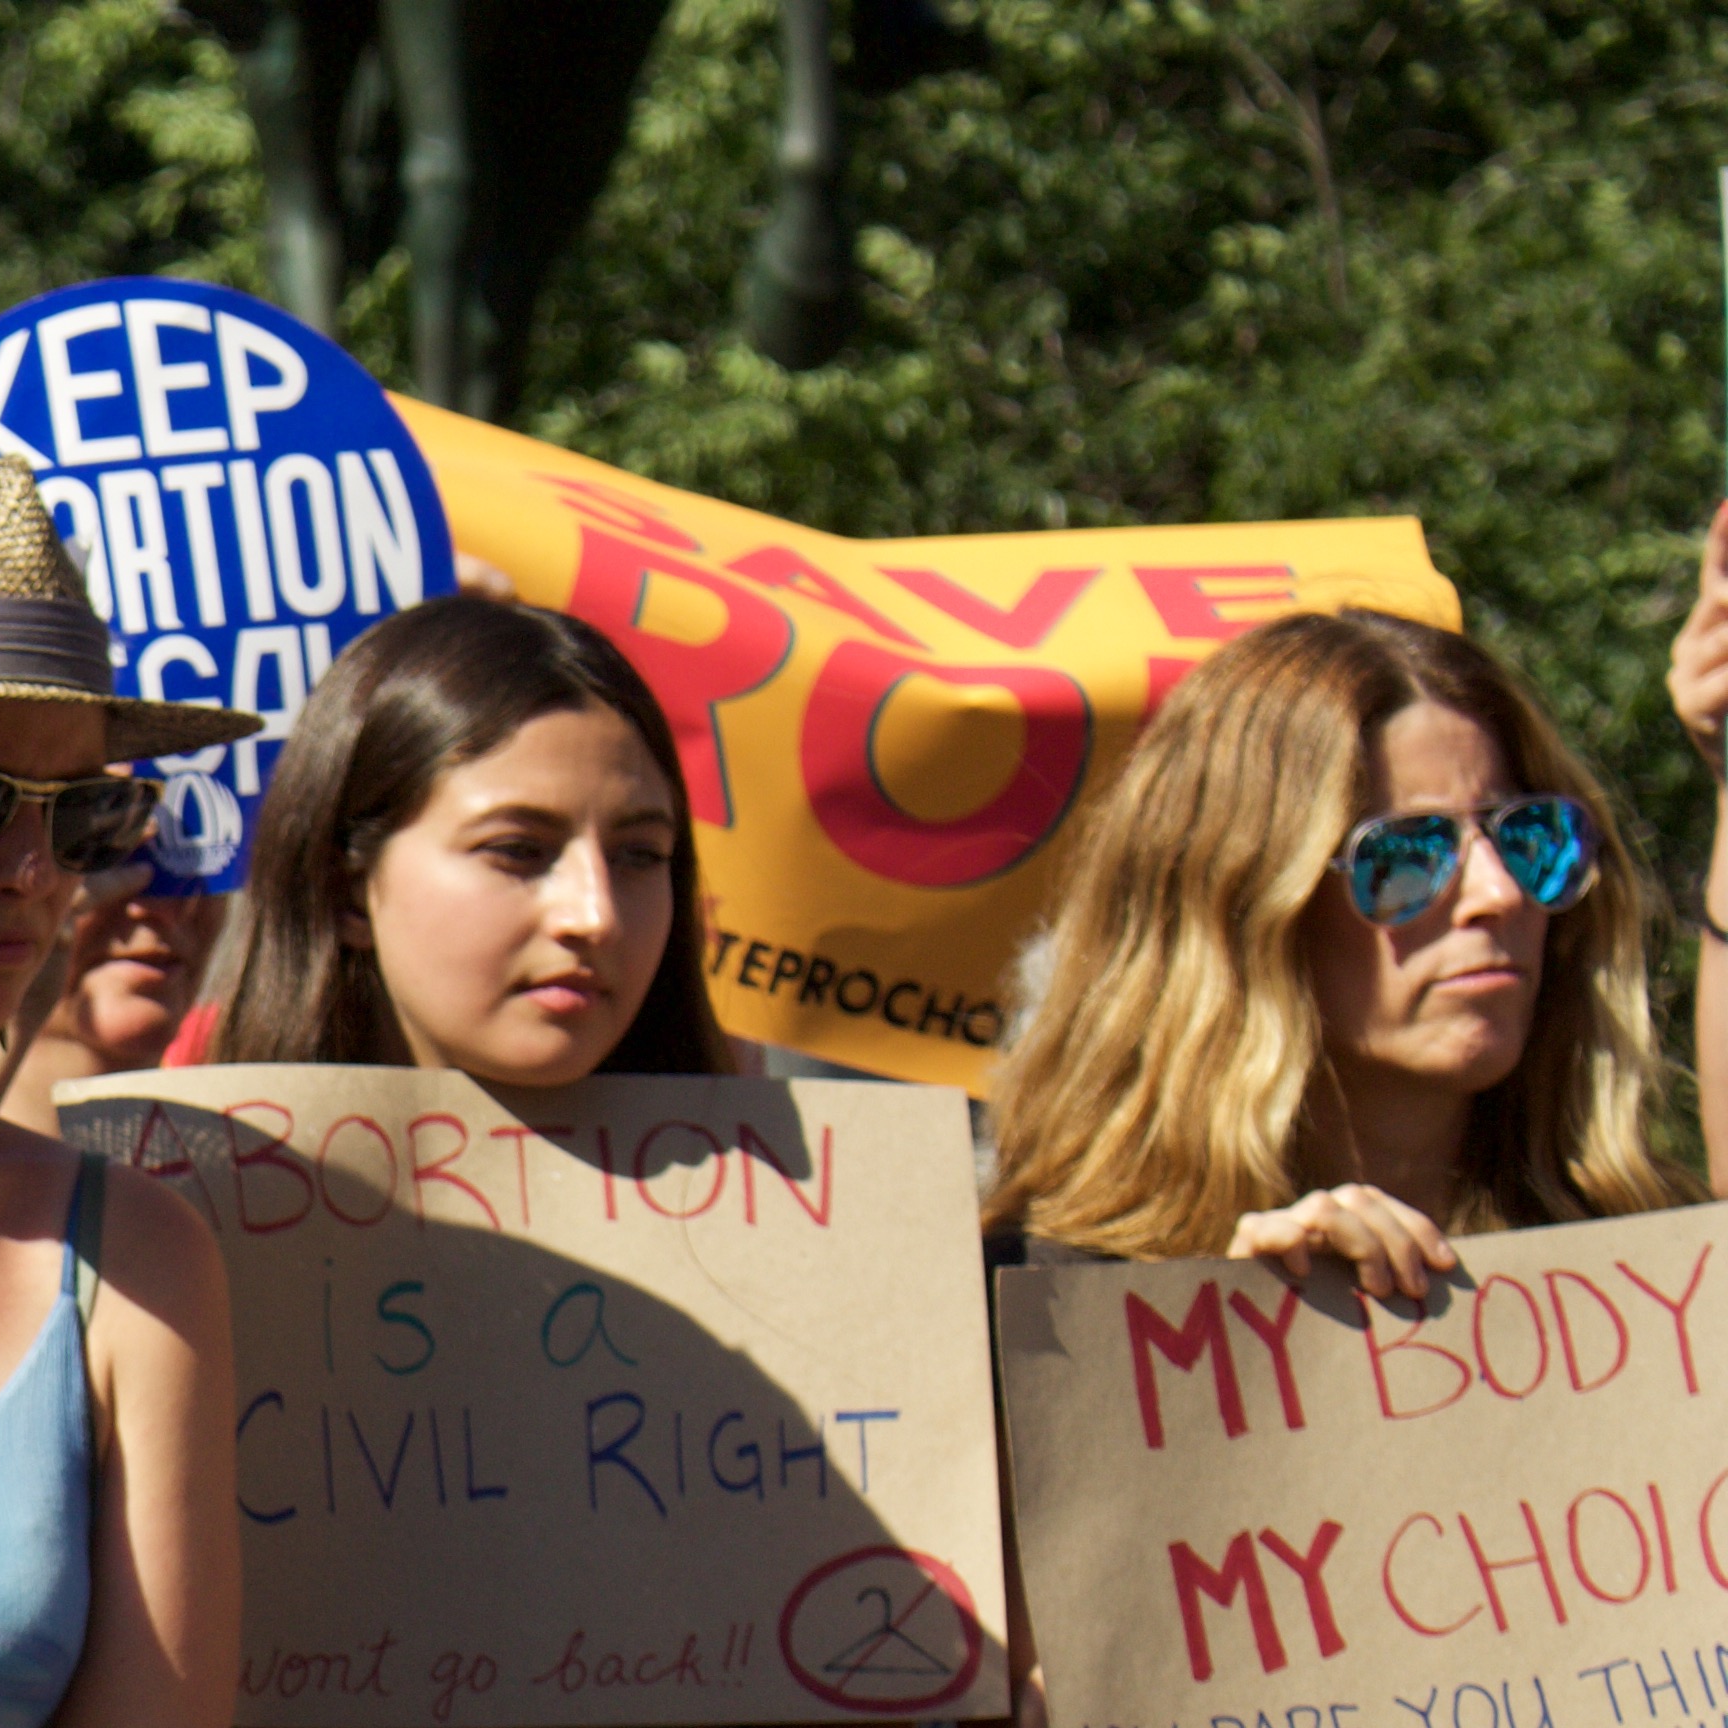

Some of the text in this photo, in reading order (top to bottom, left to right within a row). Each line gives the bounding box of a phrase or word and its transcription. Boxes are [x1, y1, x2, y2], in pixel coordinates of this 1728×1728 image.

[36, 449, 424, 636] ORTION
[529, 472, 1297, 650] SAVE
[566, 525, 1199, 890] RO
[130, 1098, 834, 1234] ABORTION
[323, 1258, 638, 1375] is a
[1123, 1243, 1714, 1451] MY BODY
[236, 1391, 900, 1524] CIVIL RIGHT
[1168, 1519, 1347, 1684] MY
[430, 1650, 498, 1722] go
